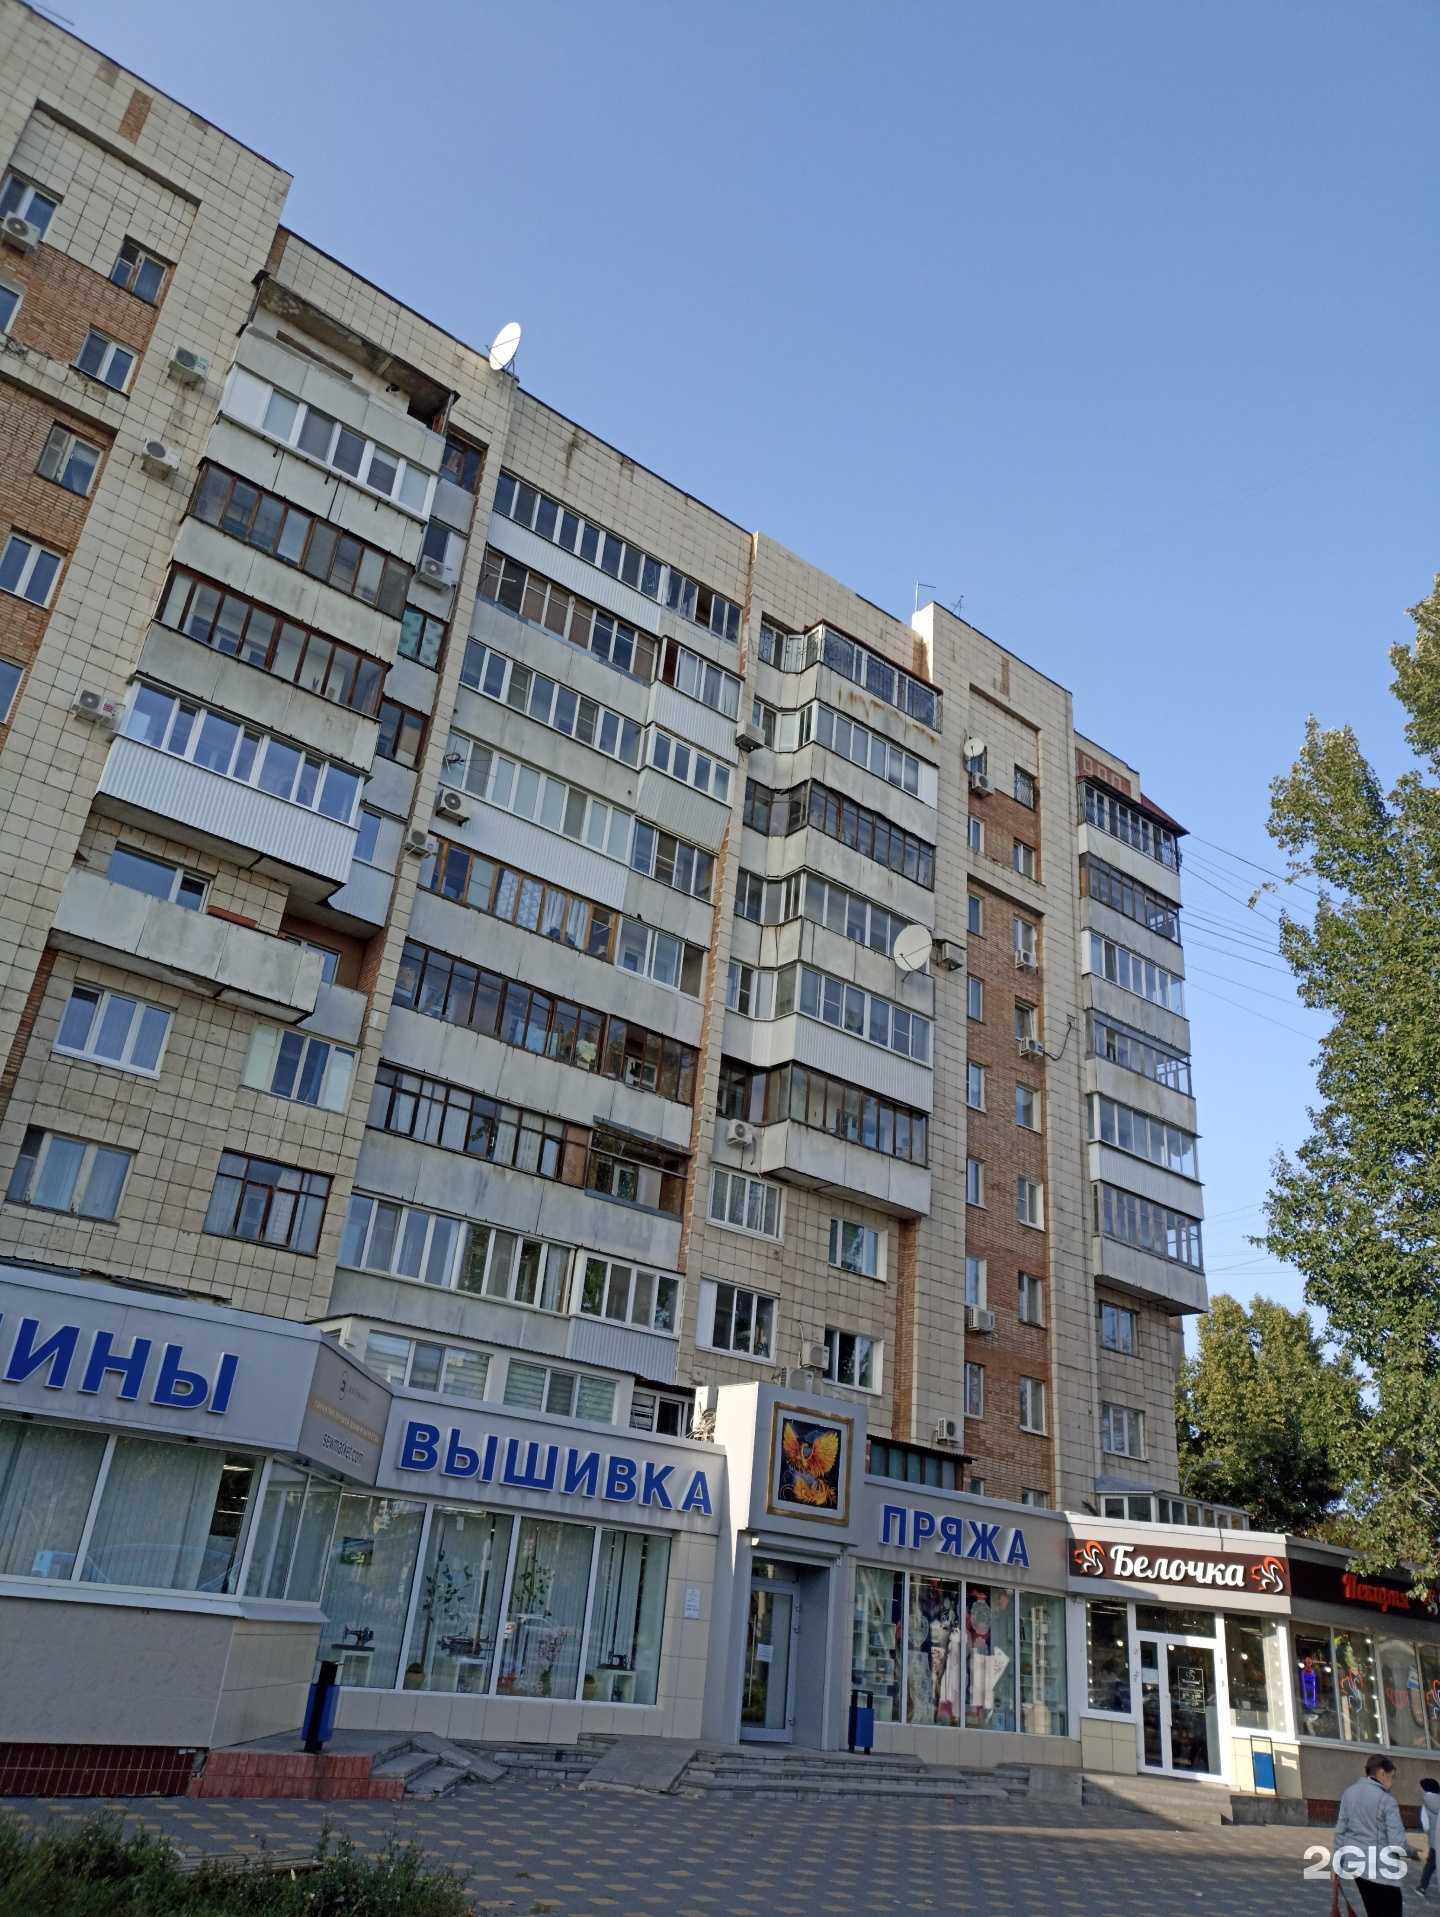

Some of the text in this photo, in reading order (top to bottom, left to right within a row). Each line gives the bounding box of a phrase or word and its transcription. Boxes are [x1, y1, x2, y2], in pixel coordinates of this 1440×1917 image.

[0, 1312, 240, 1414] ИНЫ
[397, 1420, 713, 1516] ВЫШИВКА
[880, 1503, 1030, 1568] ПРЯЖА
[1109, 1543, 1246, 1588] Белочка
